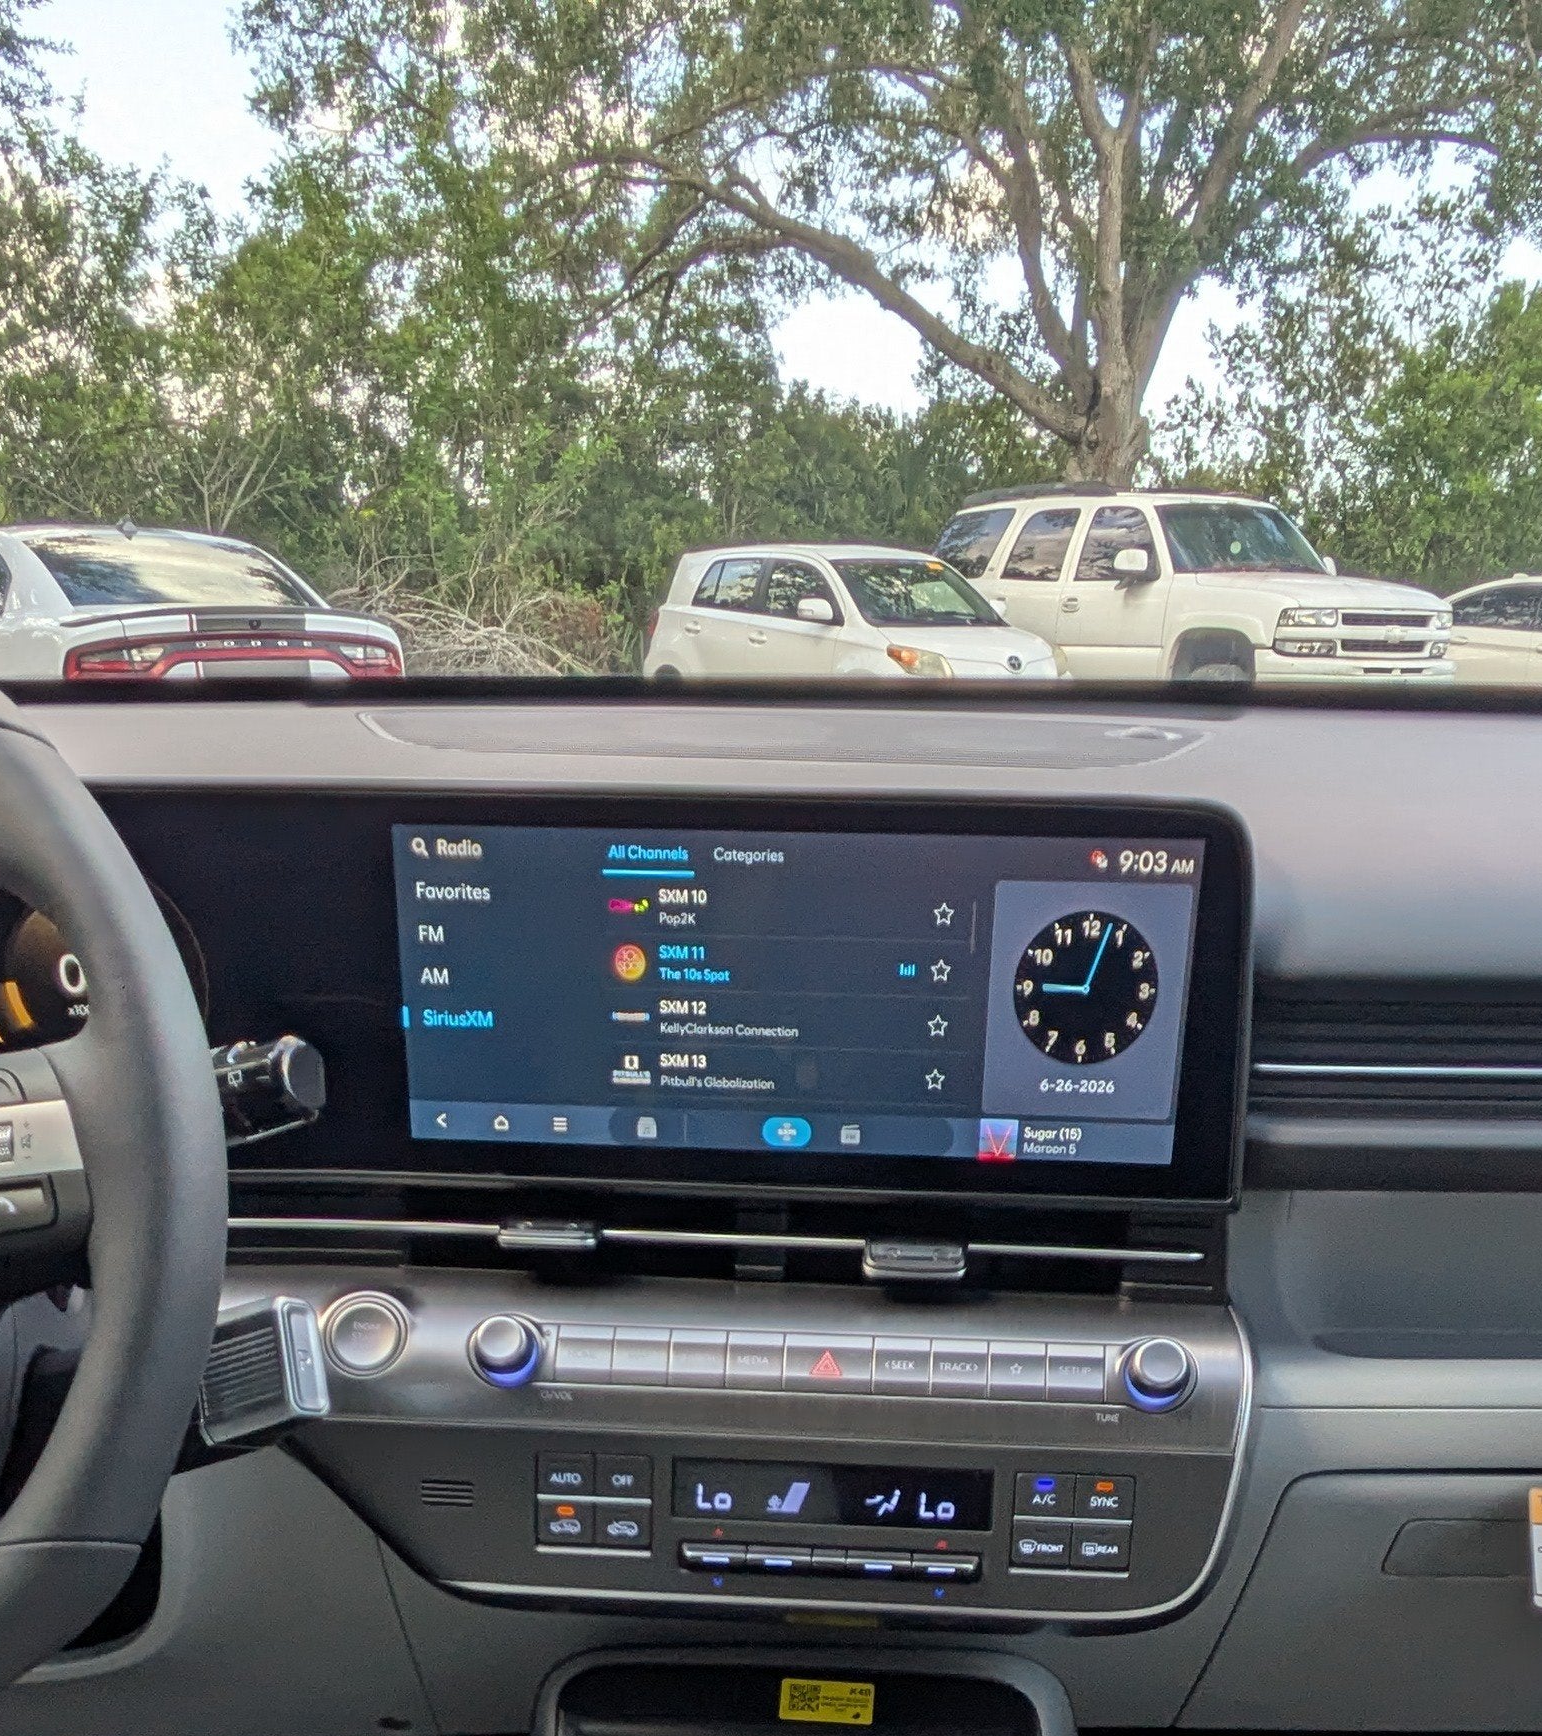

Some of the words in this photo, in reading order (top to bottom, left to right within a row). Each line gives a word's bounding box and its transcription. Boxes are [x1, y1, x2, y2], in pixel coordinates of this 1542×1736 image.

[434, 837, 483, 857] Radio
[608, 844, 626, 860] All
[627, 844, 690, 861] Channels
[713, 846, 785, 865] Categories
[1119, 850, 1169, 875] 9:03
[1171, 858, 1195, 875] AM
[415, 881, 491, 901] Favorites
[658, 888, 689, 904] SXM
[691, 889, 708, 905] 10
[659, 911, 697, 926] Pop2K
[418, 924, 446, 943] FM
[1055, 928, 1073, 946] 11
[1082, 919, 1101, 938] 12
[1115, 929, 1124, 947] 1
[659, 944, 689, 960] SXM
[691, 945, 705, 961] 11
[1034, 948, 1054, 966] 10
[1132, 950, 1144, 969] 2
[59, 953, 88, 995] 0
[420, 966, 451, 986] AM
[659, 967, 682, 981] The
[684, 967, 702, 981] 10s
[703, 968, 731, 984] Spot
[1022, 979, 1034, 997] 9
[1138, 982, 1151, 1000] 3
[659, 999, 689, 1015] SXM
[691, 1000, 707, 1016] 12
[422, 1009, 495, 1028] SiriusXM
[1028, 1009, 1040, 1026] 8
[1125, 1011, 1139, 1029] 4
[735, 1024, 800, 1038] Connection
[1047, 1030, 1059, 1047] 7
[1104, 1031, 1116, 1048] 5
[1075, 1039, 1087, 1056] 6
[660, 1053, 689, 1068] SXM
[691, 1053, 708, 1069] 13
[660, 1074, 703, 1088] Pitbull's
[704, 1076, 776, 1090] Globalization
[1039, 1078, 1116, 1094] 6-26-2026
[1023, 1126, 1057, 1142] Sugar
[1059, 1127, 1083, 1142] (15)
[1022, 1141, 1067, 1155] Maroon
[1068, 1143, 1077, 1155] 5
[737, 1355, 769, 1366] MEDIA
[549, 1472, 582, 1485] AUTO
[611, 1474, 634, 1487] OFF
[695, 1482, 732, 1512] Lo
[1031, 1493, 1056, 1506] A/C
[1090, 1496, 1119, 1508] SYNC
[918, 1491, 955, 1521] Lo
[1038, 1543, 1064, 1554] FRONT
[1098, 1545, 1119, 1555] REAR
